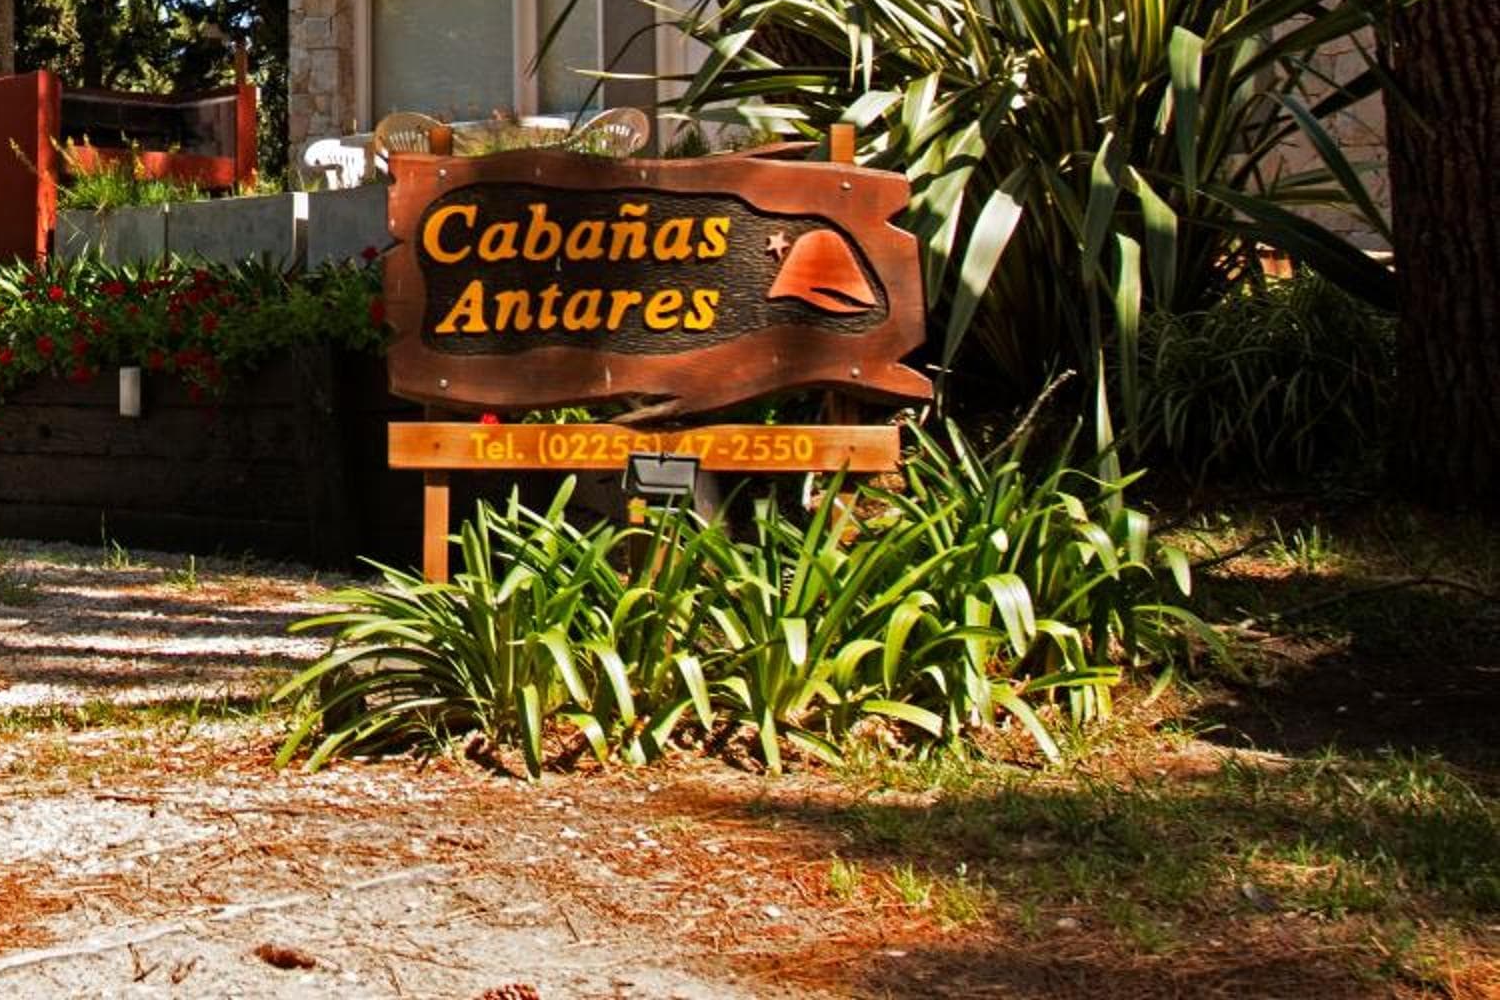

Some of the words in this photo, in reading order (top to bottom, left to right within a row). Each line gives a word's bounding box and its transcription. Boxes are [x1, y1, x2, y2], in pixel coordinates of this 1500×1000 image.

[422, 202, 731, 264] Cabañas
[435, 279, 720, 334] Antares
[471, 432, 525, 461] Tel.
[675, 433, 813, 462] 47-2550
